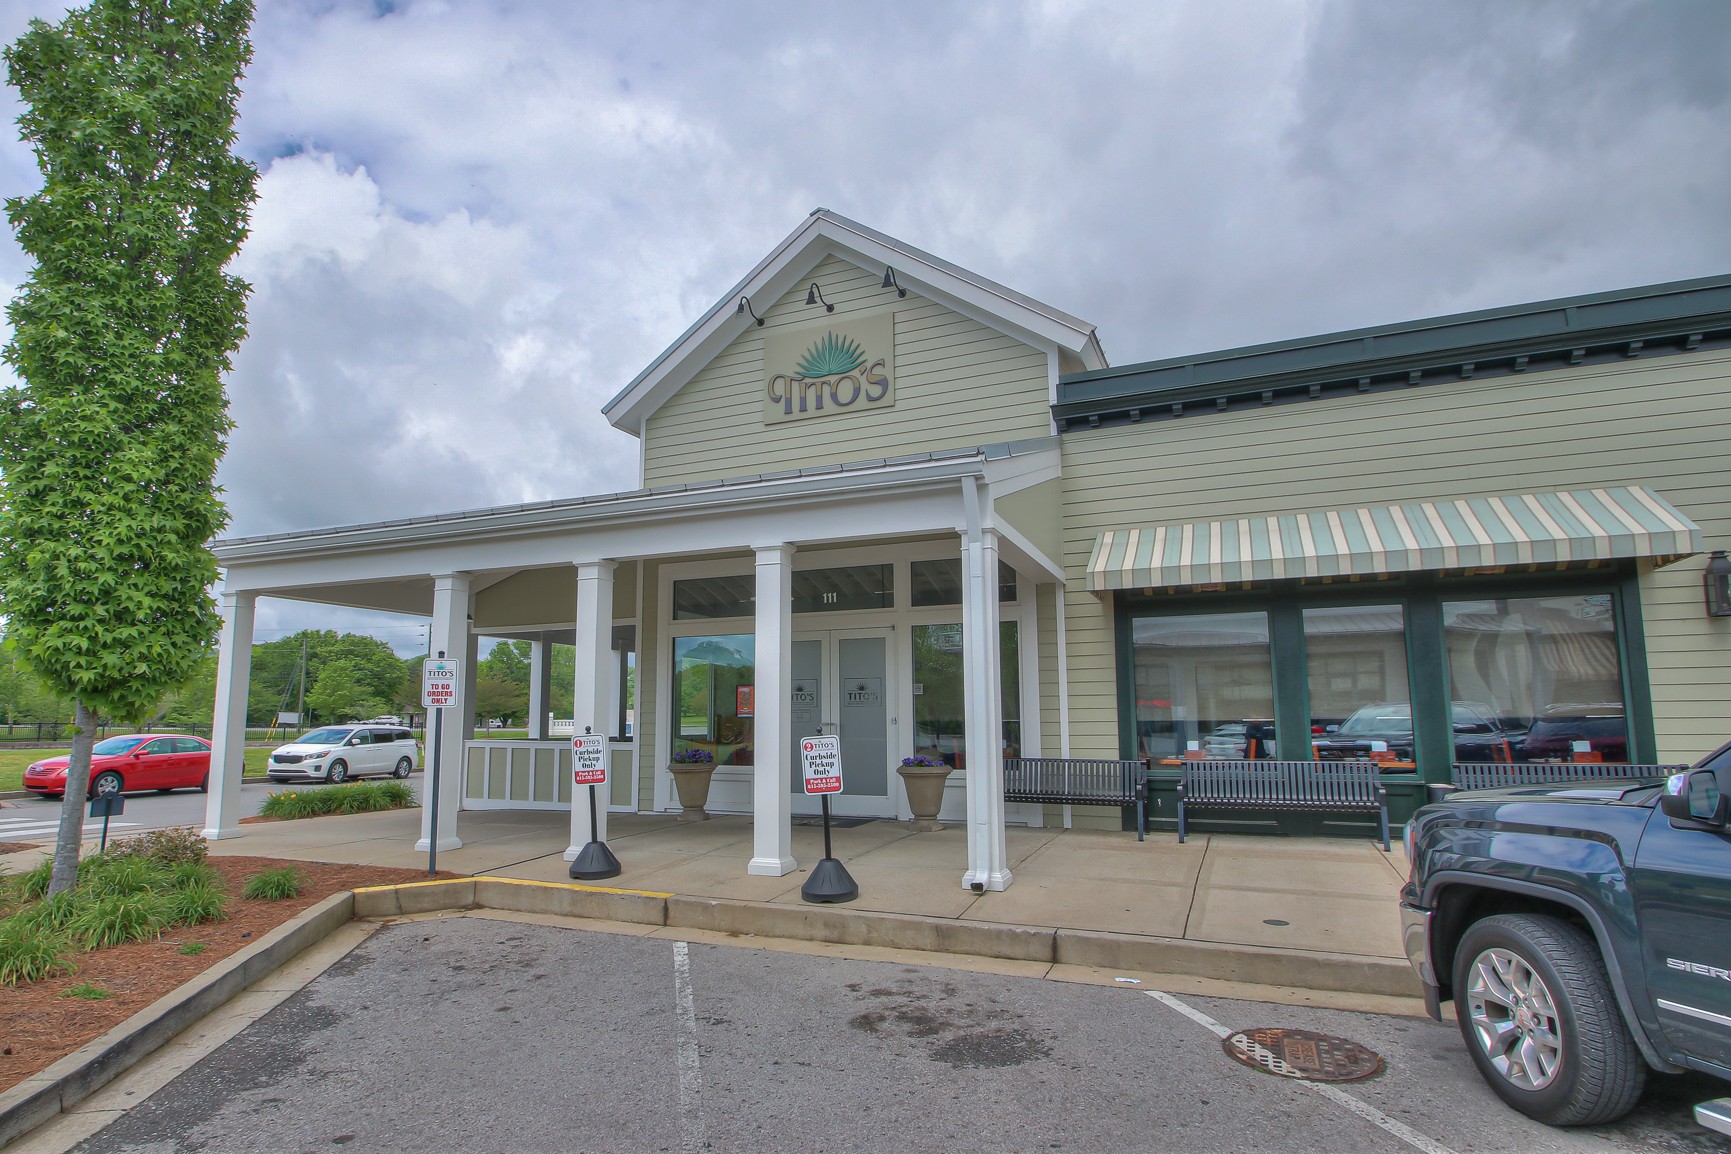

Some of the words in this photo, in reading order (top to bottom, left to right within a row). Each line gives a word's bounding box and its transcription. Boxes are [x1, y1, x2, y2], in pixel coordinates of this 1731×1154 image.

[822, 592, 837, 603] 111
[791, 693, 814, 701] ITO'S
[847, 692, 878, 700] TITO'S
[805, 752, 837, 761] Curbside
[813, 768, 830, 776] Only
[1667, 958, 1731, 981] SIER
